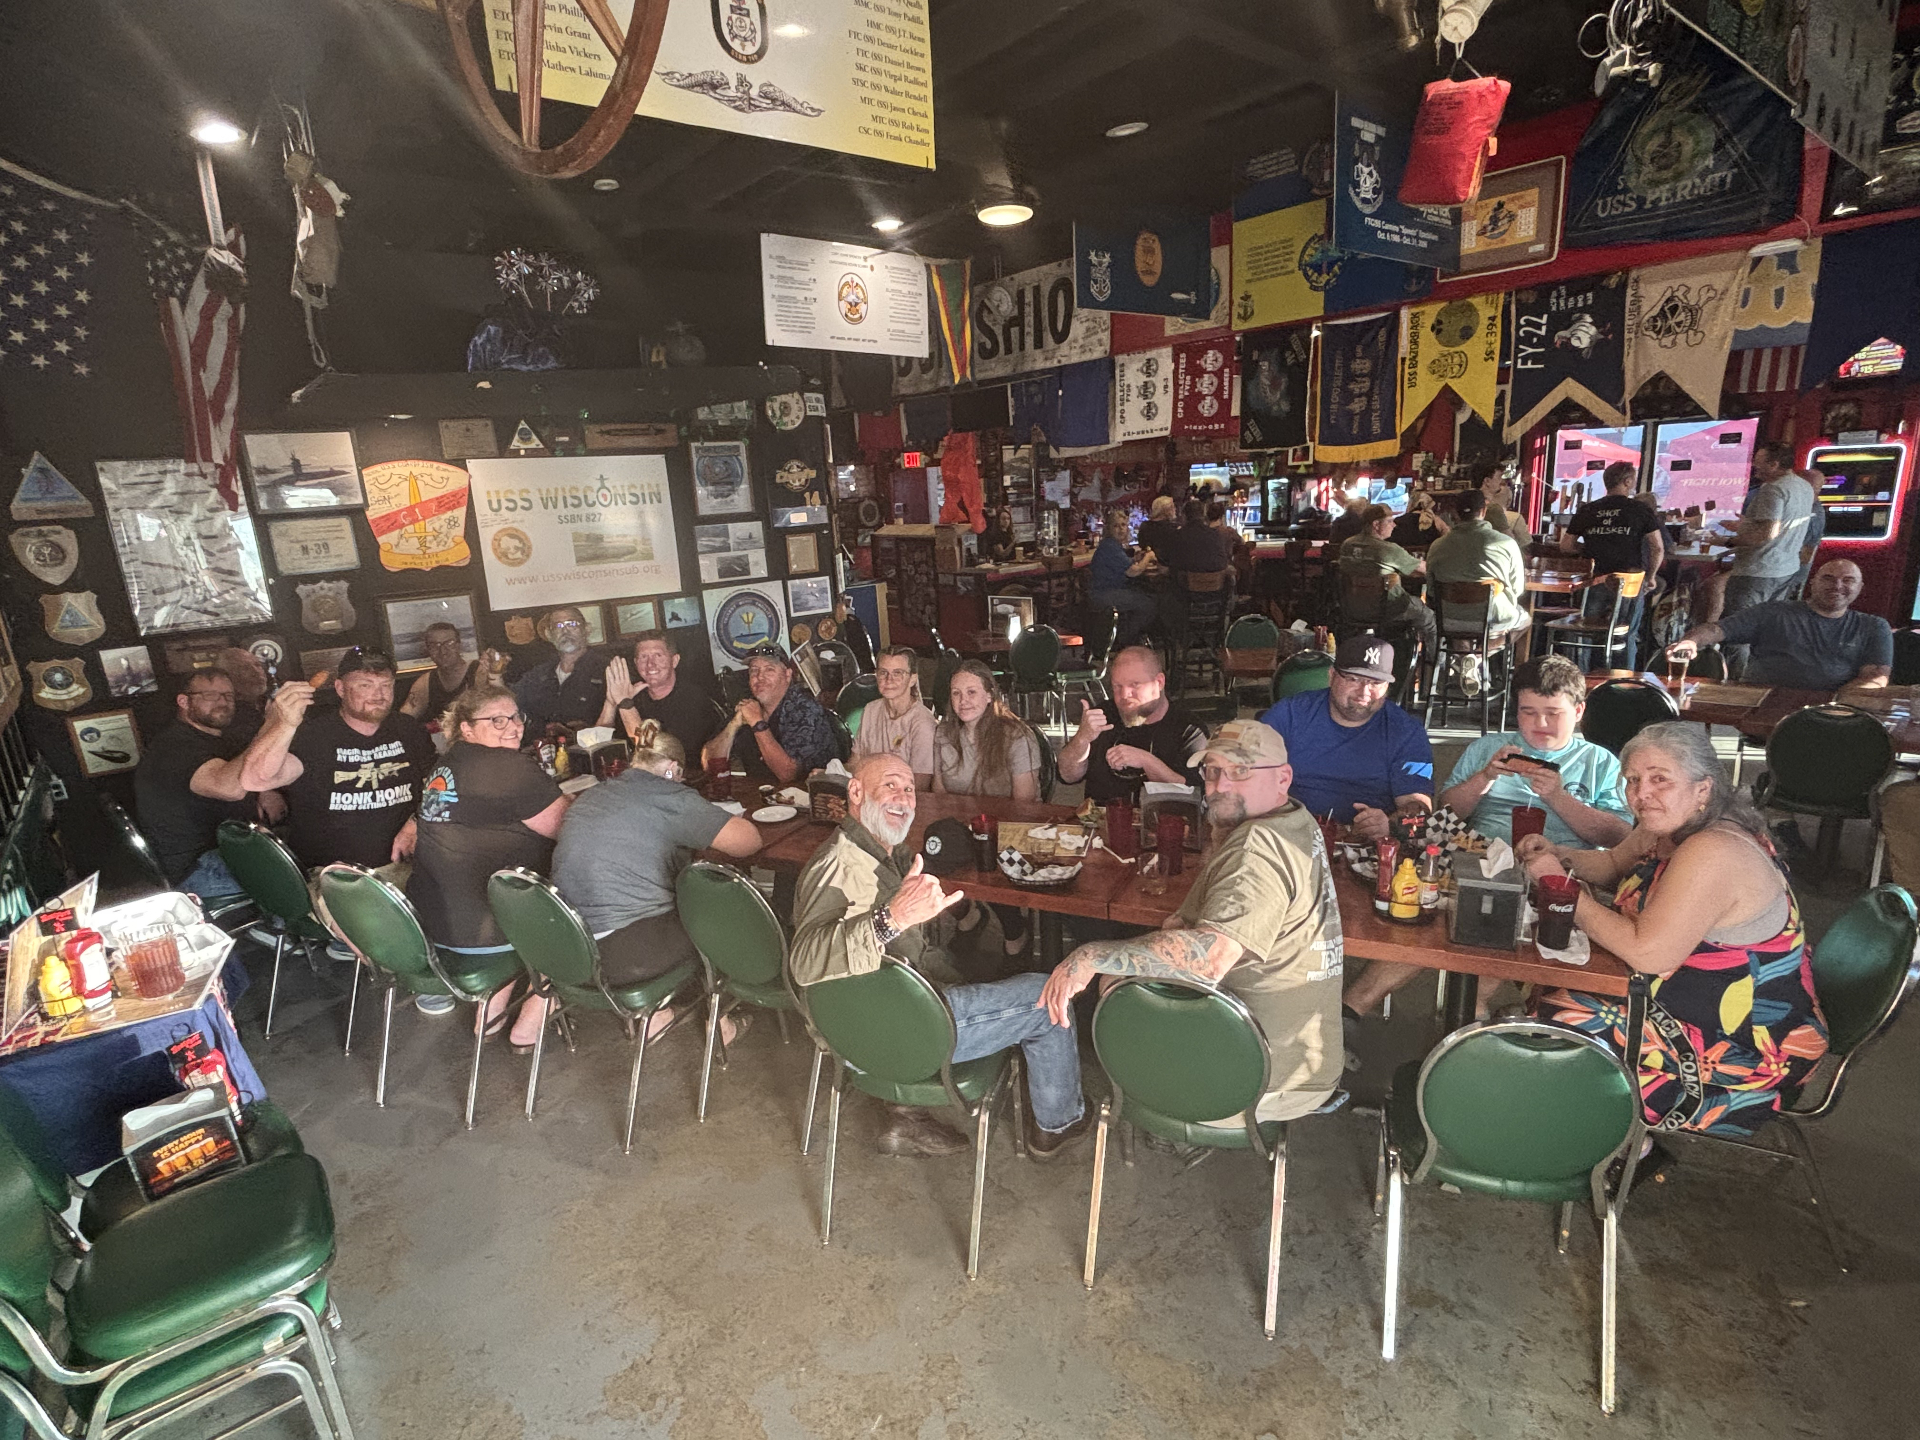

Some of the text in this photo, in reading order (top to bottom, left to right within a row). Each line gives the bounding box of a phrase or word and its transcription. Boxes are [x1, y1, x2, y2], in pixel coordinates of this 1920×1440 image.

[565, 25, 592, 41] Grant
[570, 44, 602, 62] Vickers
[885, 133, 902, 145] Frank
[1597, 193, 1638, 218] USS
[1517, 313, 1549, 369] FY-22
[1118, 362, 1126, 407] SELECTEES
[1178, 352, 1187, 400] SELECTEES
[487, 487, 533, 513] USS
[539, 483, 663, 511] WISCONSIN
[557, 512, 603, 525] SSBN 827
[1596, 508, 1622, 518] SHOT
[1602, 517, 1613, 526] of
[505, 564, 661, 587] www.usswisconsinsub.org
[1363, 646, 1381, 665] NY
[329, 803, 358, 811] BEFORE
[358, 799, 387, 810] GETTING
[330, 783, 412, 806] HONK HONK
[1680, 1052, 1701, 1100] COACH
